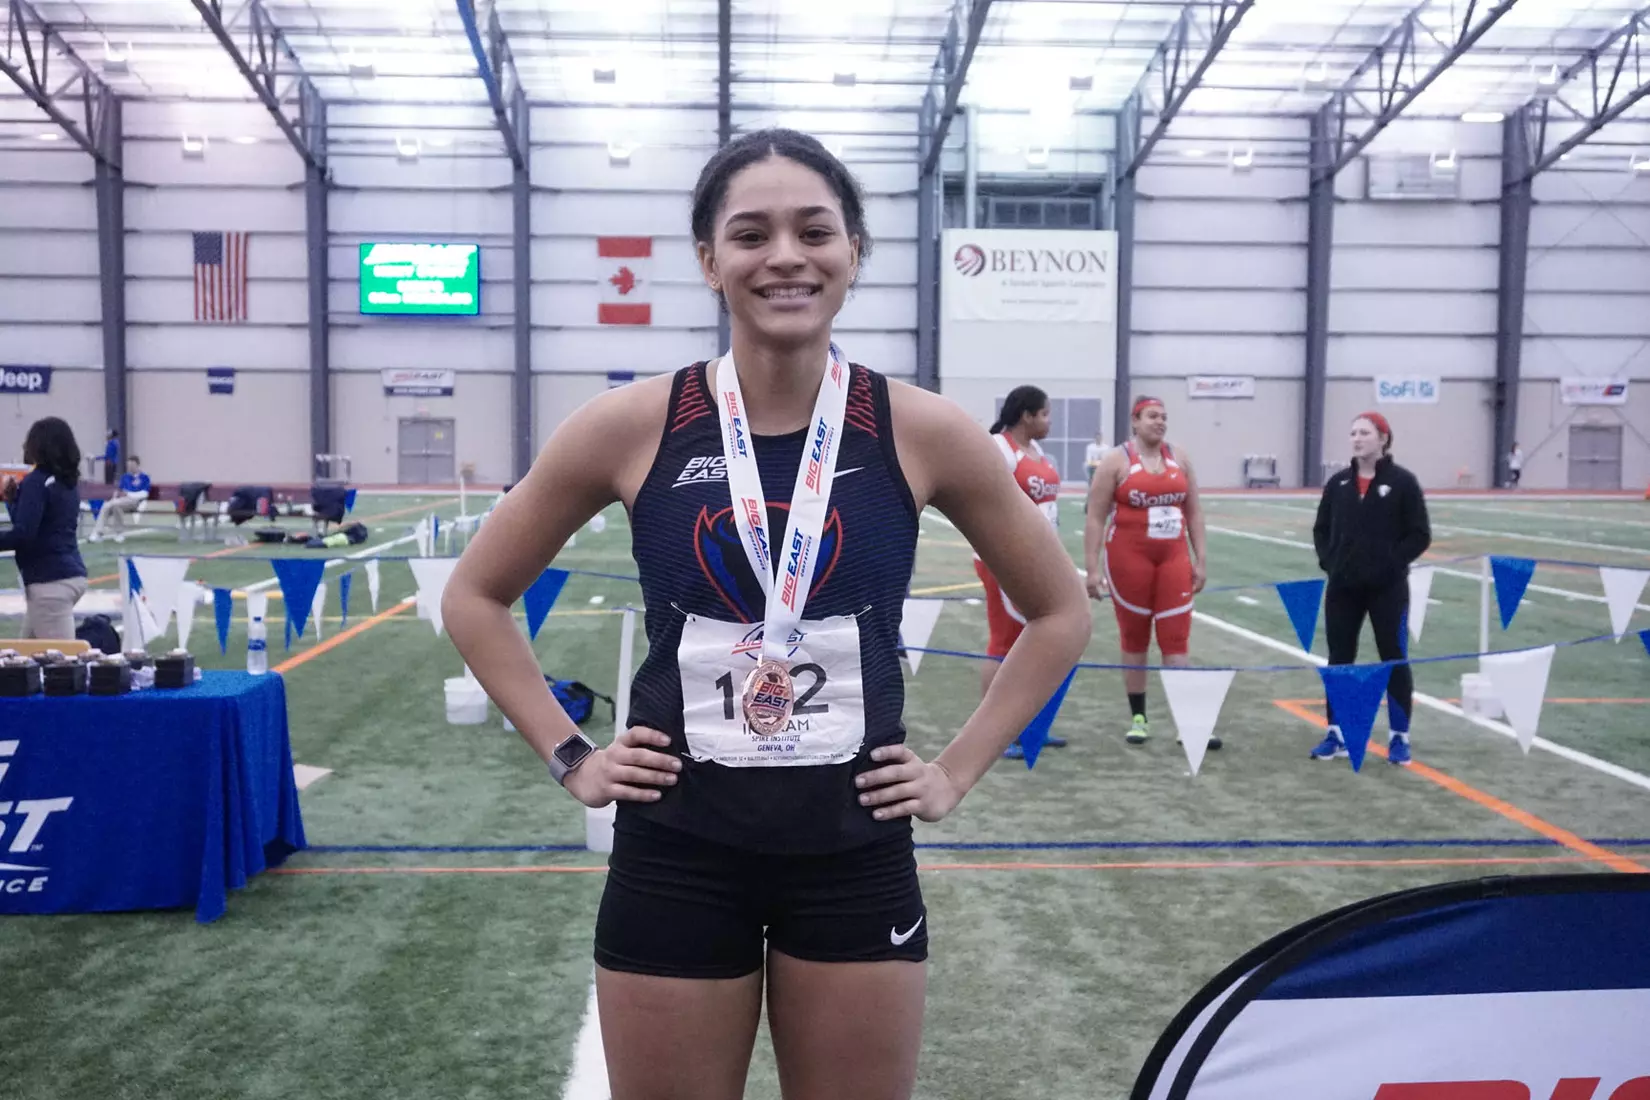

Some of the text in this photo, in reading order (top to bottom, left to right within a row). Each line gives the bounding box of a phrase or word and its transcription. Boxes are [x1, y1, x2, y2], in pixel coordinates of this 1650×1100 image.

[990, 248, 1108, 273] BEYNON
[1380, 380, 1416, 397] SoFi
[729, 391, 748, 458] BIG EAST
[685, 455, 727, 469] BIG
[805, 416, 828, 491] BIG EAST
[677, 467, 728, 481] EAS
[748, 498, 769, 562] BIG EAS
[780, 526, 804, 606] BIG EAST
[715, 663, 829, 720] 12
[760, 682, 786, 696] BIG
[753, 693, 790, 708] EAST
[757, 744, 796, 753] GENEVA, OH
